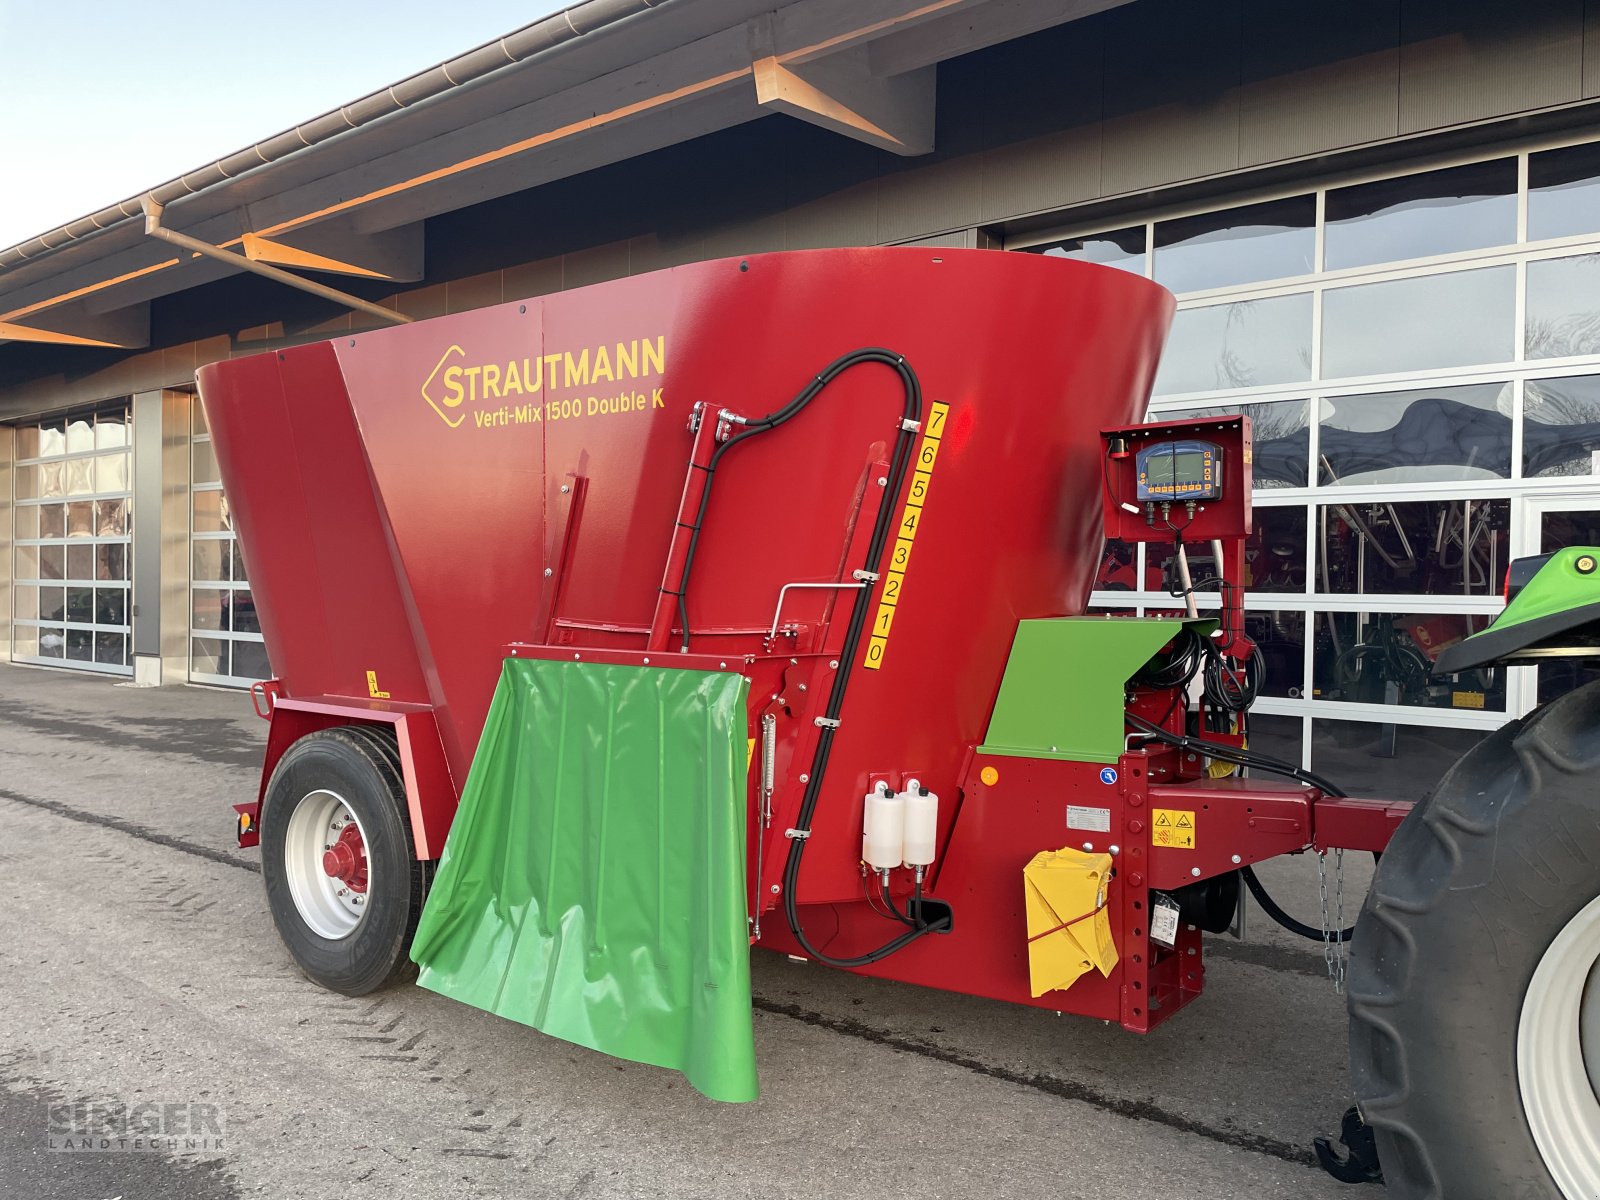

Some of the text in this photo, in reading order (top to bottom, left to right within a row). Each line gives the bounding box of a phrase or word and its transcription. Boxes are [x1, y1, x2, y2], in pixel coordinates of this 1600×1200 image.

[442, 336, 665, 408] STRAUTMANN
[473, 388, 665, 428] Verti-Mix 1500 Double K
[932, 411, 944, 428] 7
[921, 446, 934, 464] 6
[913, 480, 926, 497] 5
[904, 514, 916, 532] 4
[895, 547, 907, 565] 3
[885, 580, 899, 598] 2
[881, 613, 890, 630] 1
[870, 644, 882, 661] 0
